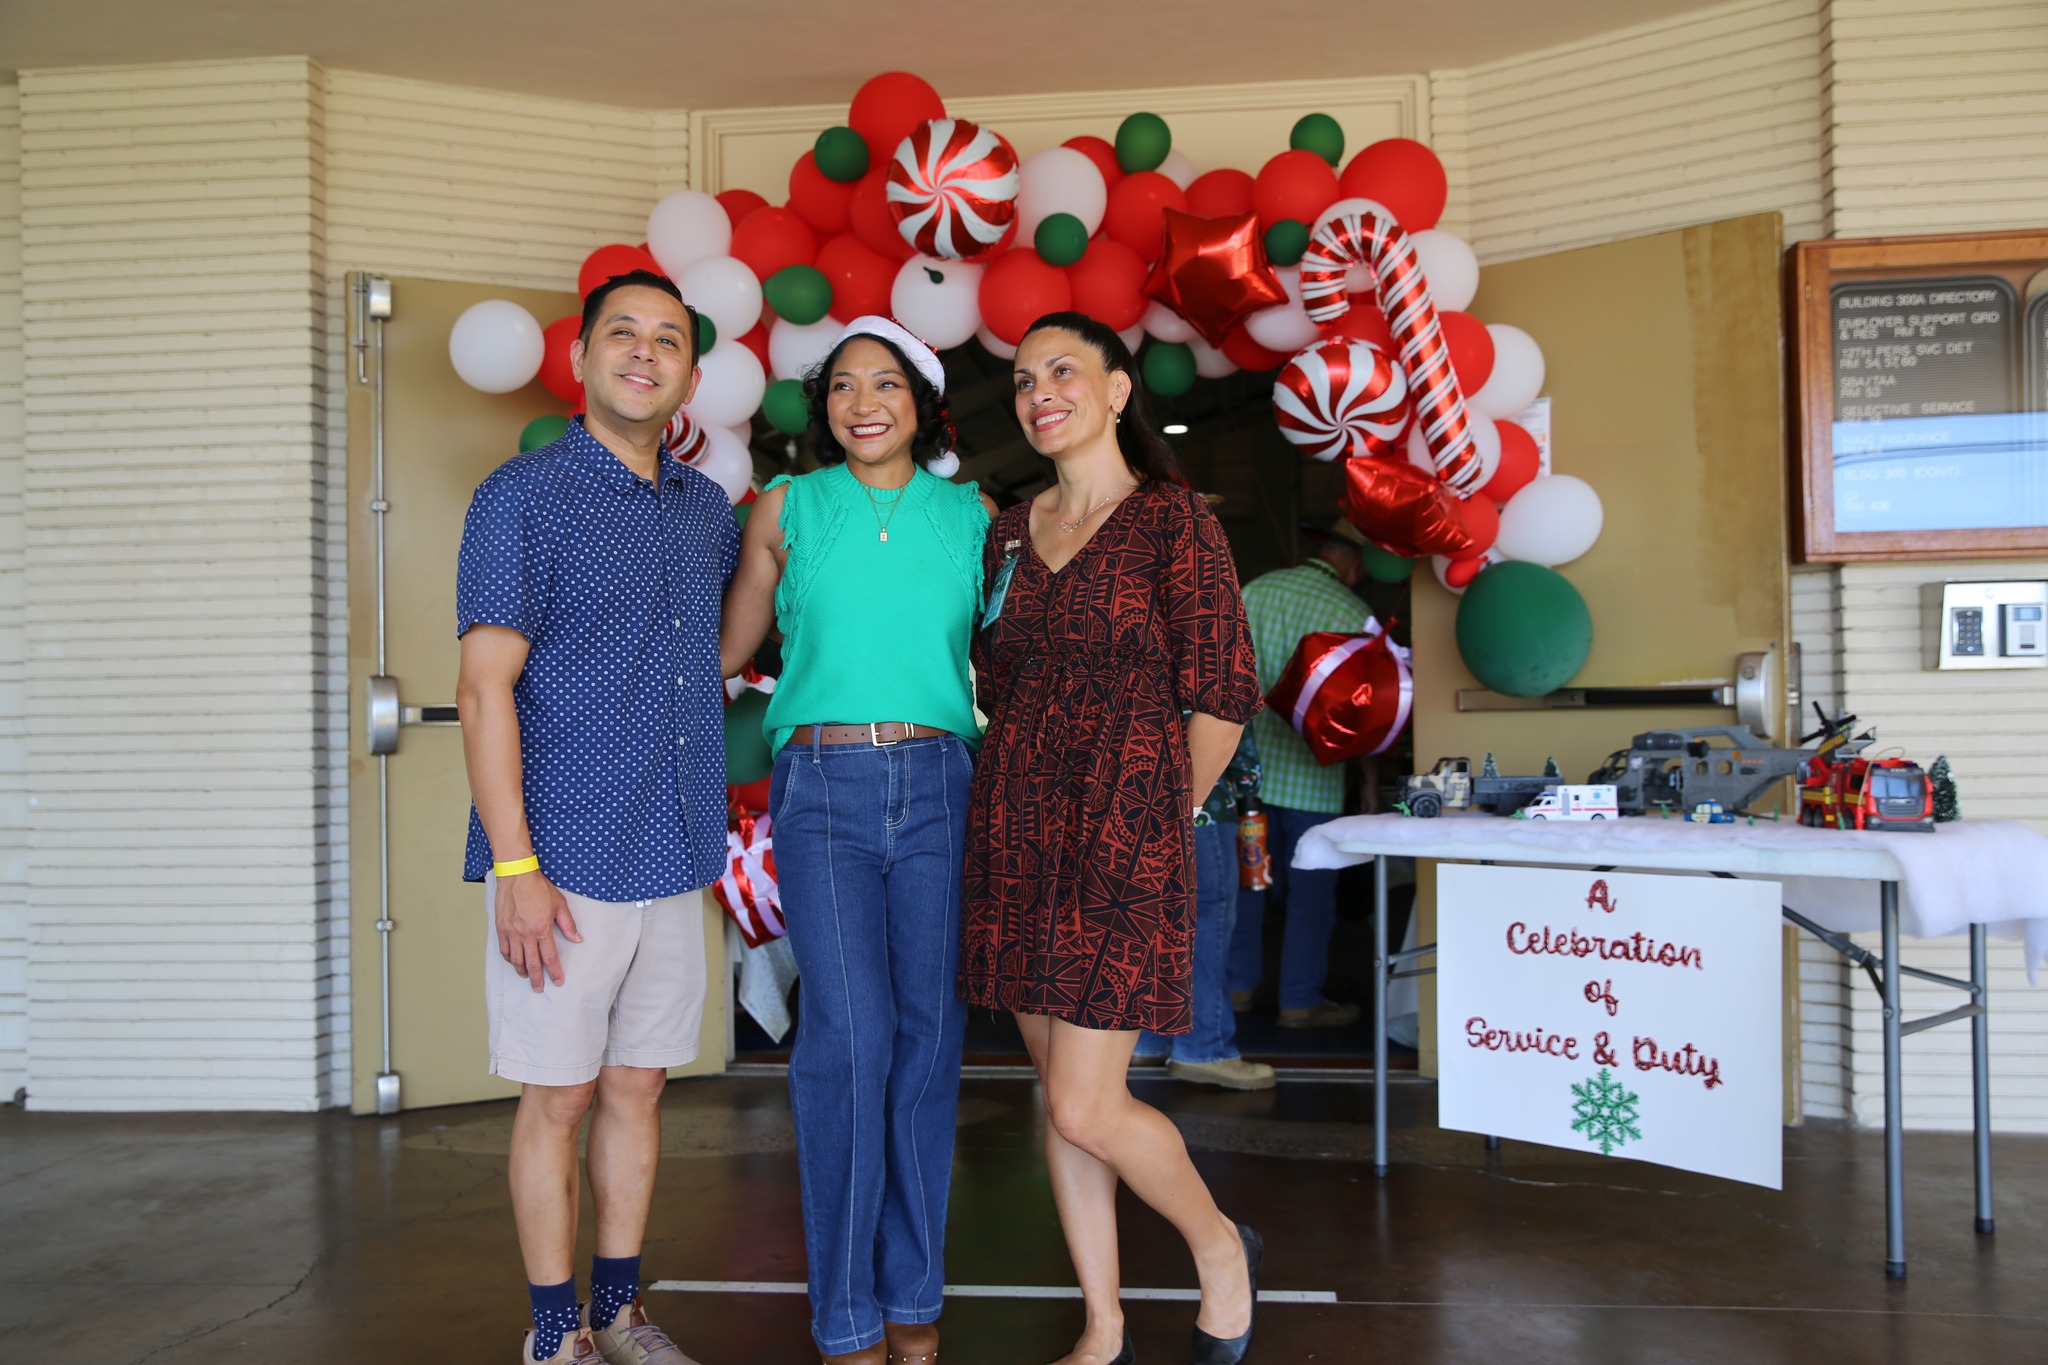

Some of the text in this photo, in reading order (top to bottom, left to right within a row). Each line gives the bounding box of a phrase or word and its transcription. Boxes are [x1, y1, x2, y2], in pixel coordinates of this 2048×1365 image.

[1839, 295, 1894, 309] BUILDING
[1929, 290, 1997, 304] DIRECTORY
[1839, 315, 1904, 330] EMPLOYER
[1908, 312, 1967, 327] SUPPORT
[1915, 343, 1942, 356] SVC
[1946, 341, 1974, 354] DET
[1841, 400, 1976, 417] SELECTIVE SERVICE
[1584, 879, 1617, 913] A
[1507, 921, 1703, 970] Celebration
[1584, 979, 1619, 1016] of
[1465, 1016, 1724, 1089] Service & Duty
